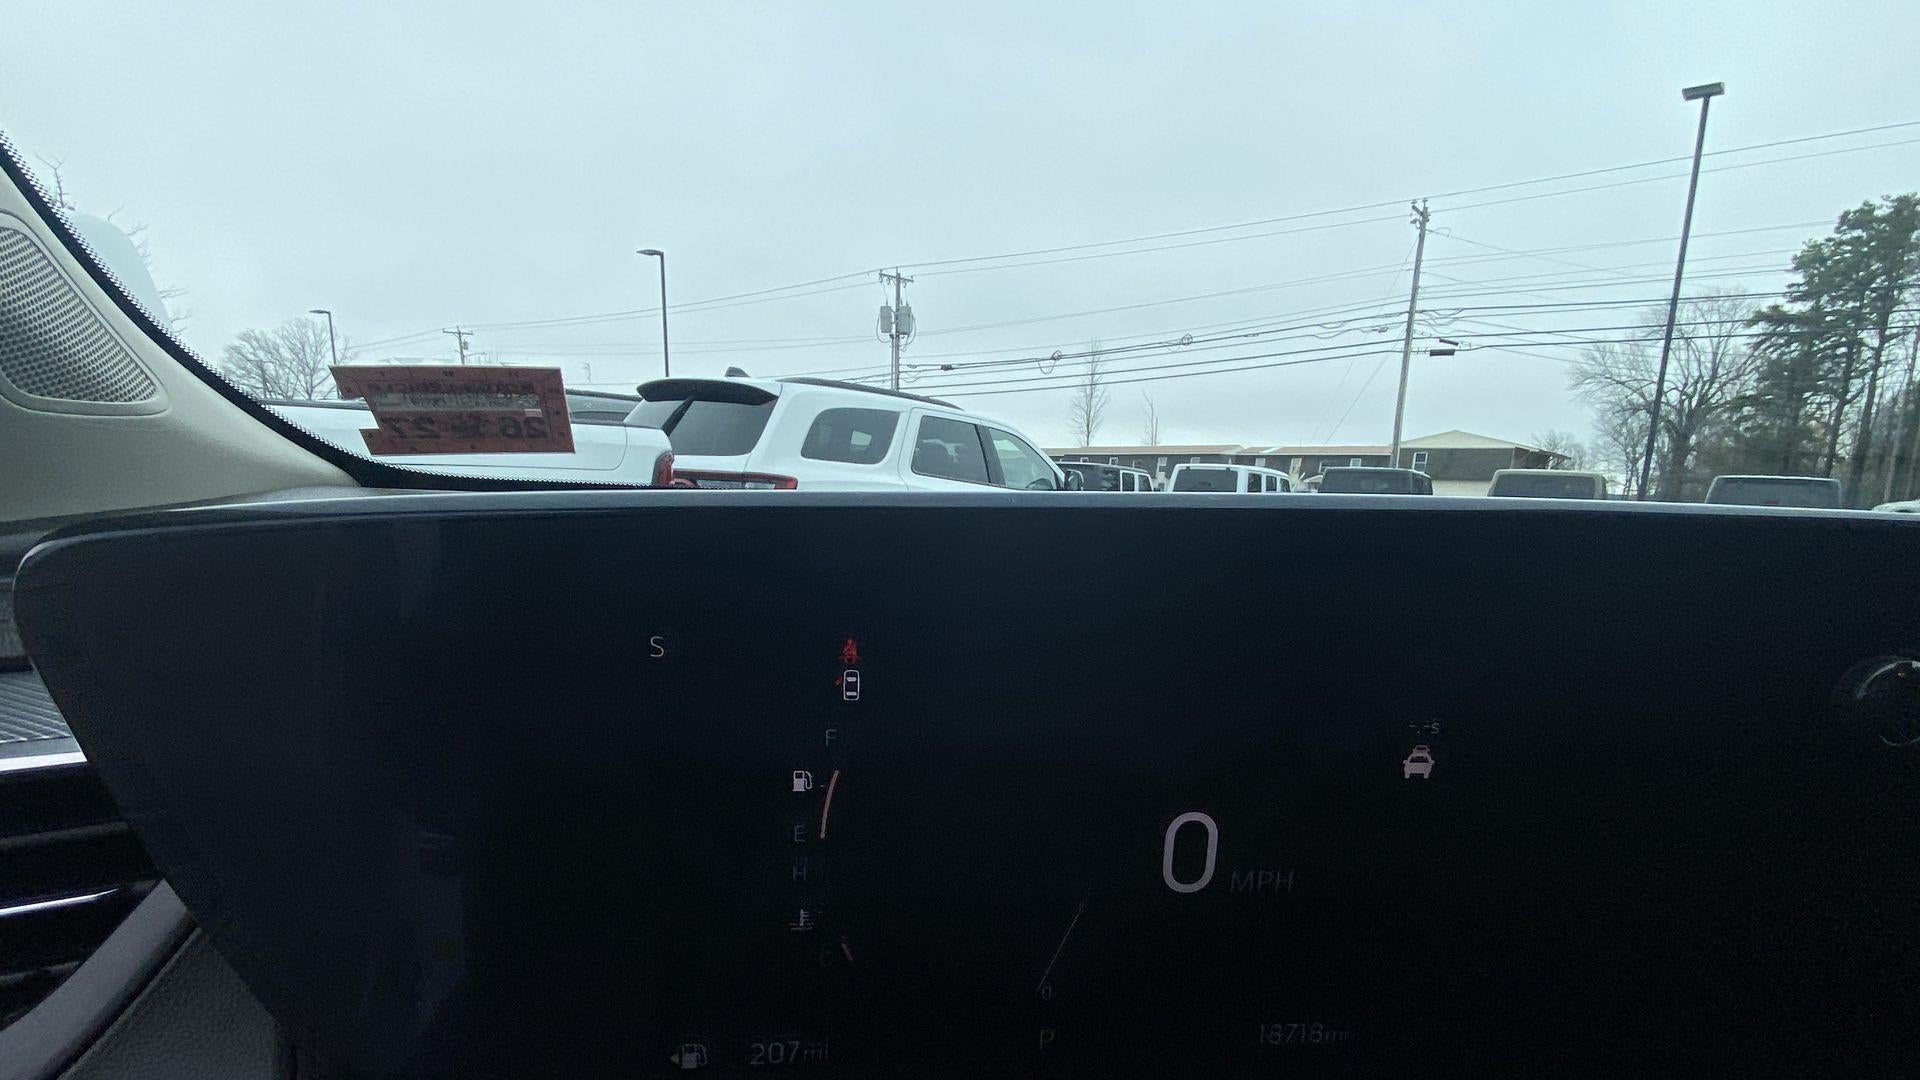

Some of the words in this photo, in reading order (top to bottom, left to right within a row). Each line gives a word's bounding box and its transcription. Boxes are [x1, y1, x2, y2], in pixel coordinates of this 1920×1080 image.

[649, 635, 665, 658] S
[825, 728, 839, 746] F
[793, 823, 807, 843] E
[1162, 811, 1219, 894] 0
[1230, 870, 1294, 894] MPH
[792, 865, 807, 882] H
[1039, 1028, 1055, 1050] P
